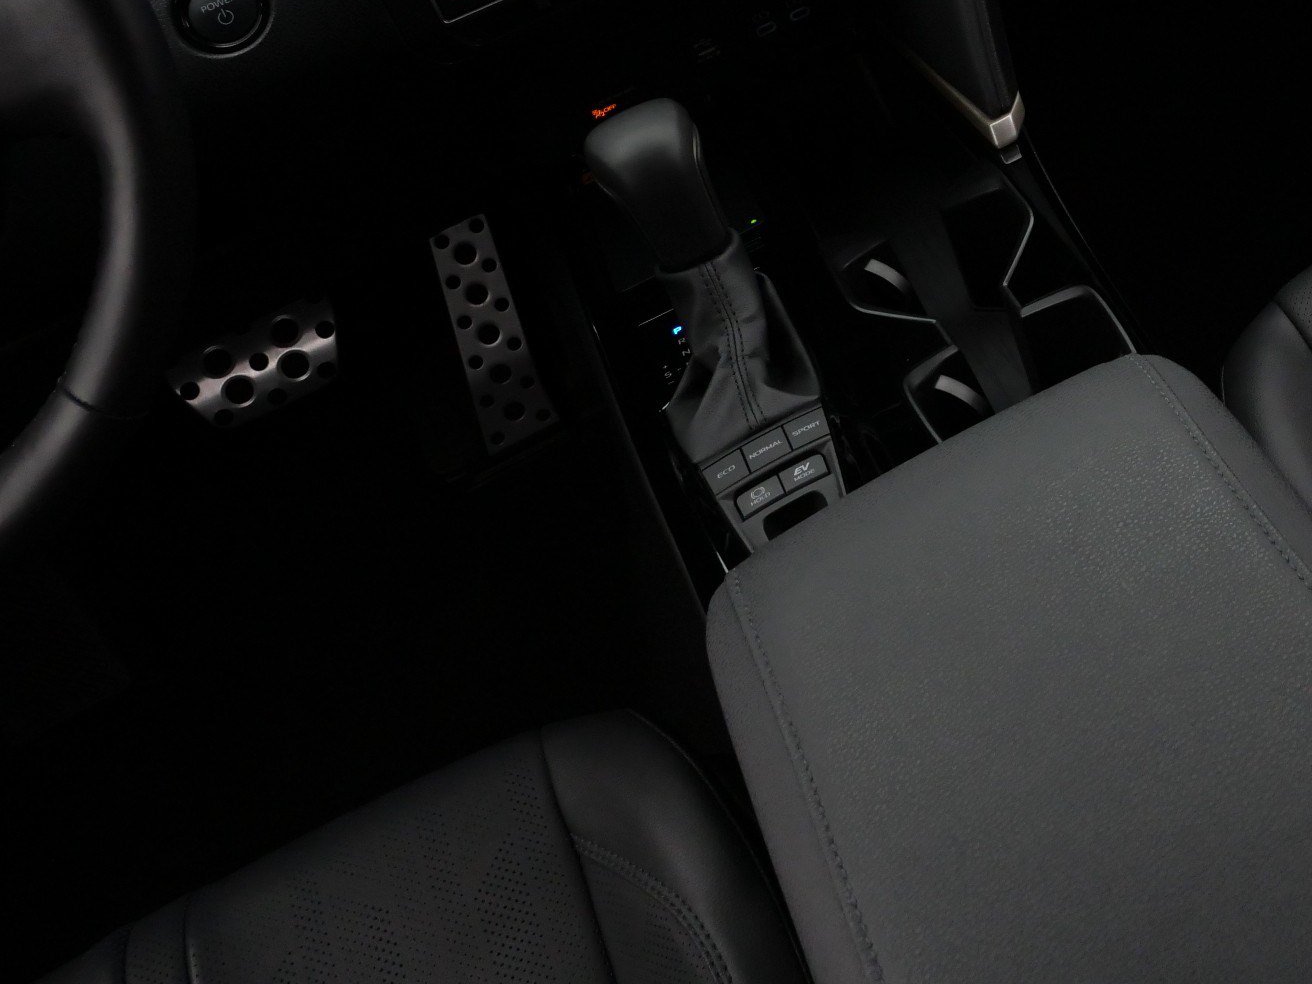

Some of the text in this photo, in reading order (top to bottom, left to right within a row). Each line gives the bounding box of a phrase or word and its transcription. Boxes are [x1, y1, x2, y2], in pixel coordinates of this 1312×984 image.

[673, 326, 682, 335] P
[682, 348, 690, 356] N
[792, 420, 820, 437] SPORT
[749, 439, 783, 460] NORMAL
[717, 464, 736, 479] ECO
[793, 462, 810, 476] EV
[794, 468, 815, 482] MODE
[751, 491, 771, 506] HOLD
